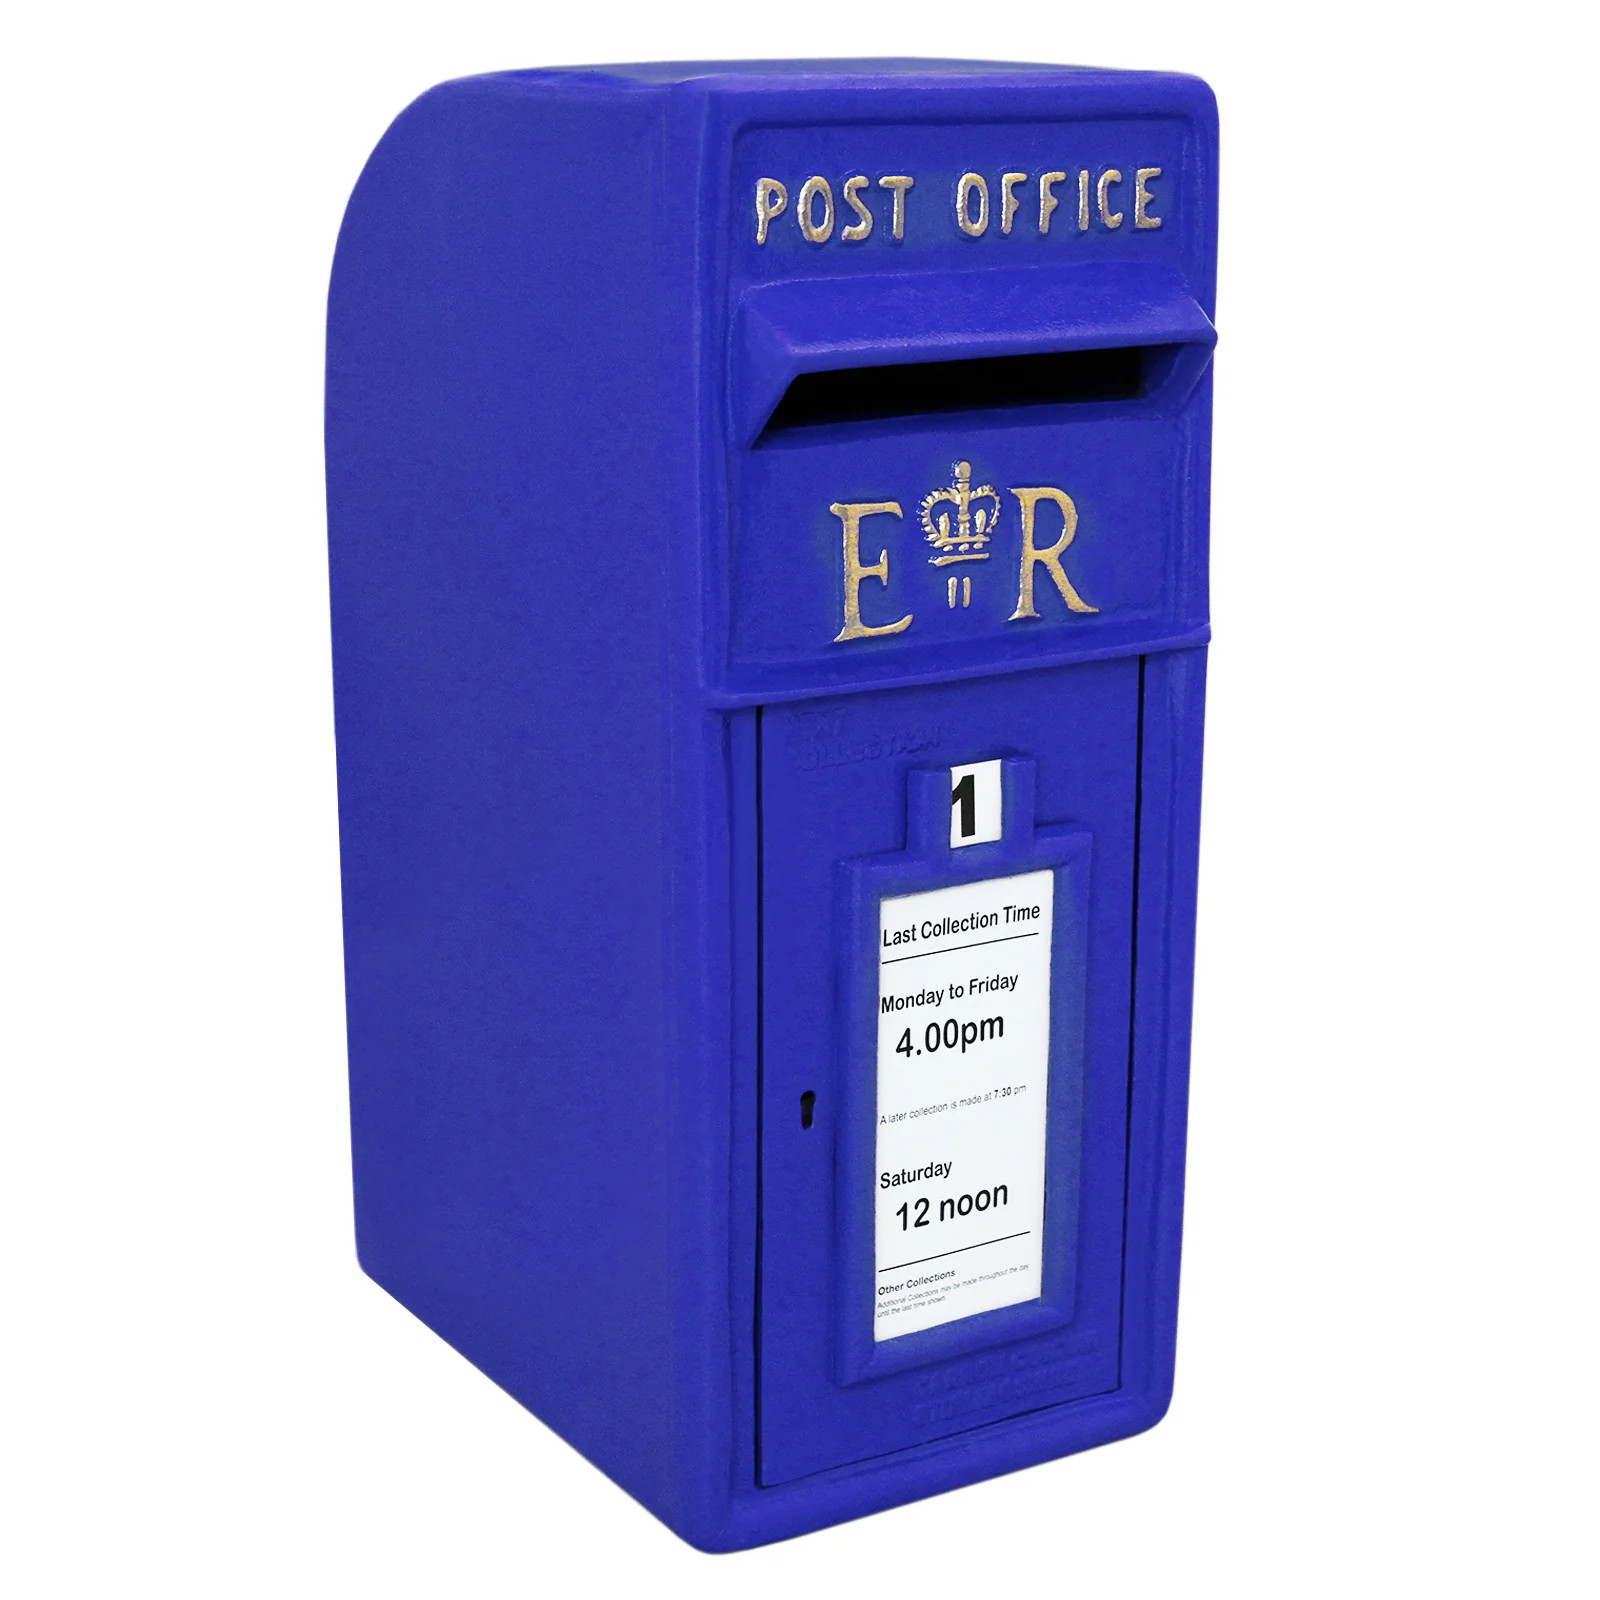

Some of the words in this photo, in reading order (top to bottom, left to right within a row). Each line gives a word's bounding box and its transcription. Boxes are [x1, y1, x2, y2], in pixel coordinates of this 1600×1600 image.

[756, 175, 914, 244] POST
[956, 168, 1162, 236] OFFICE
[829, 501, 914, 642] E
[1007, 486, 1100, 621] R
[952, 774, 976, 838] 1
[883, 924, 917, 947] Last
[921, 911, 998, 940] Collection
[1003, 904, 1041, 926] Time
[881, 986, 945, 1014] Monday
[949, 983, 965, 1000] to
[969, 973, 1019, 996] Friday
[895, 1015, 1004, 1058] 4.00pm
[880, 1115, 887, 1125] A
[888, 1112, 907, 1123] later
[909, 1103, 948, 1119] collection
[950, 1101, 957, 1110] is
[959, 1095, 982, 1107] made
[984, 1092, 992, 1102] at
[994, 1086, 1012, 1099] 7:30
[1014, 1084, 1027, 1096] pm
[880, 1161, 953, 1189] Saturday
[896, 1197, 930, 1231] 12
[939, 1184, 1008, 1222] noon
[878, 1283, 904, 1296] Other
[906, 1270, 956, 1289] Collections
